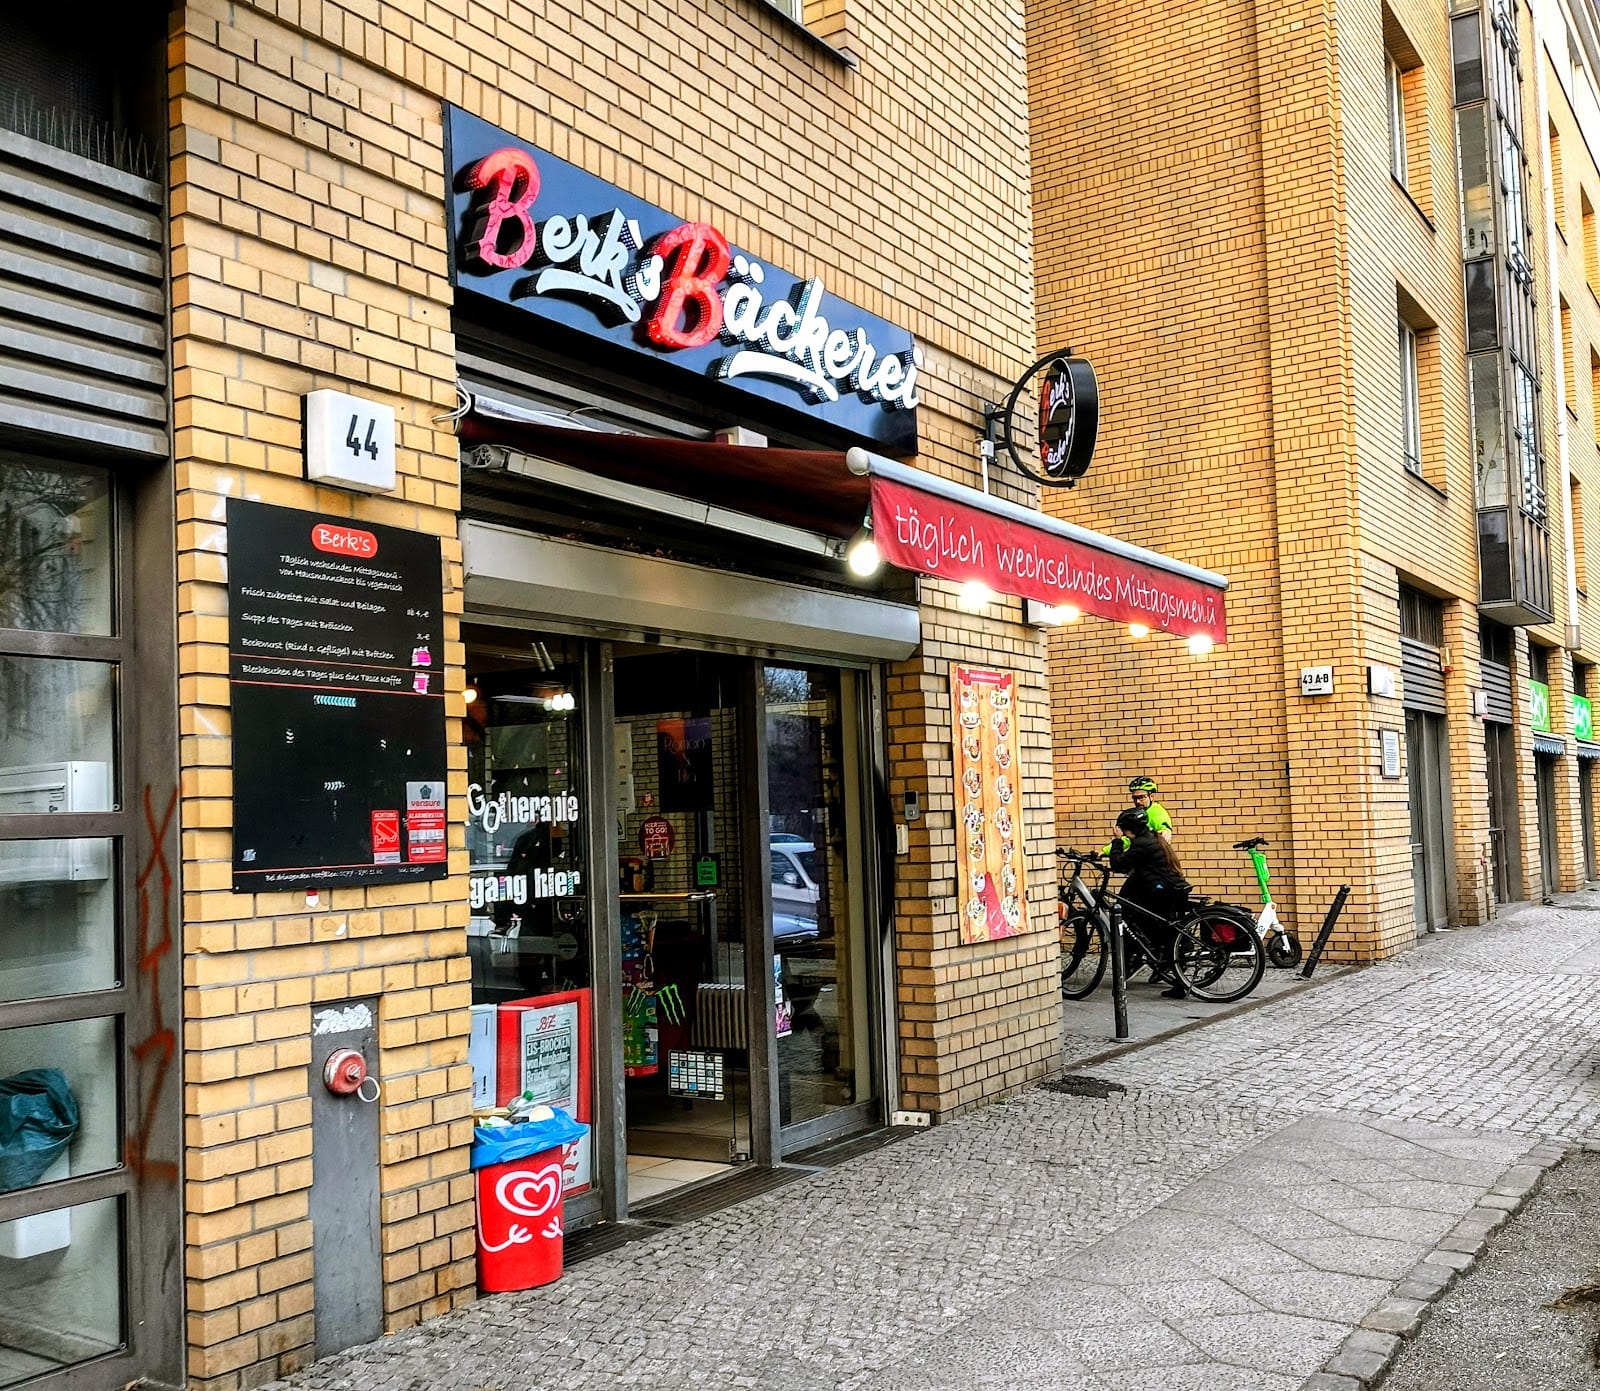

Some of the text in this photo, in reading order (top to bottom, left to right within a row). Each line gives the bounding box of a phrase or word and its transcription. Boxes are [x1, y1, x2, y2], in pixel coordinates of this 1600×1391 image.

[466, 147, 920, 410] Berk's Bäckerei
[346, 414, 378, 460] 44
[317, 527, 371, 552] Berk's
[280, 555, 309, 567] Täglich
[309, 560, 352, 573] wechselndes
[896, 503, 1217, 627] täglich wechselndes Mittagsmenü
[279, 568, 403, 592] von Hausmannskost bis vegetarisch
[241, 586, 266, 598] Frisch
[266, 590, 303, 602] zubereitet
[303, 594, 318, 604] mit
[319, 597, 340, 607] Salat
[340, 600, 356, 609] und
[241, 612, 355, 632] Suppe des Tages mit Brötchen
[284, 640, 308, 651] (Rind
[316, 644, 351, 657] Geflügel)
[351, 647, 366, 657] mit
[241, 664, 292, 676] Blechkuchen
[292, 667, 305, 677] des
[305, 670, 329, 681] Tages
[328, 671, 345, 682] plus
[360, 674, 380, 683] Tasse
[380, 675, 402, 687] Kaffee
[1302, 673, 1329, 684] 43 A-B
[410, 799, 441, 807] verisure
[470, 867, 581, 909] gang hier
[526, 1034, 571, 1057] EIS-BROCKEN
